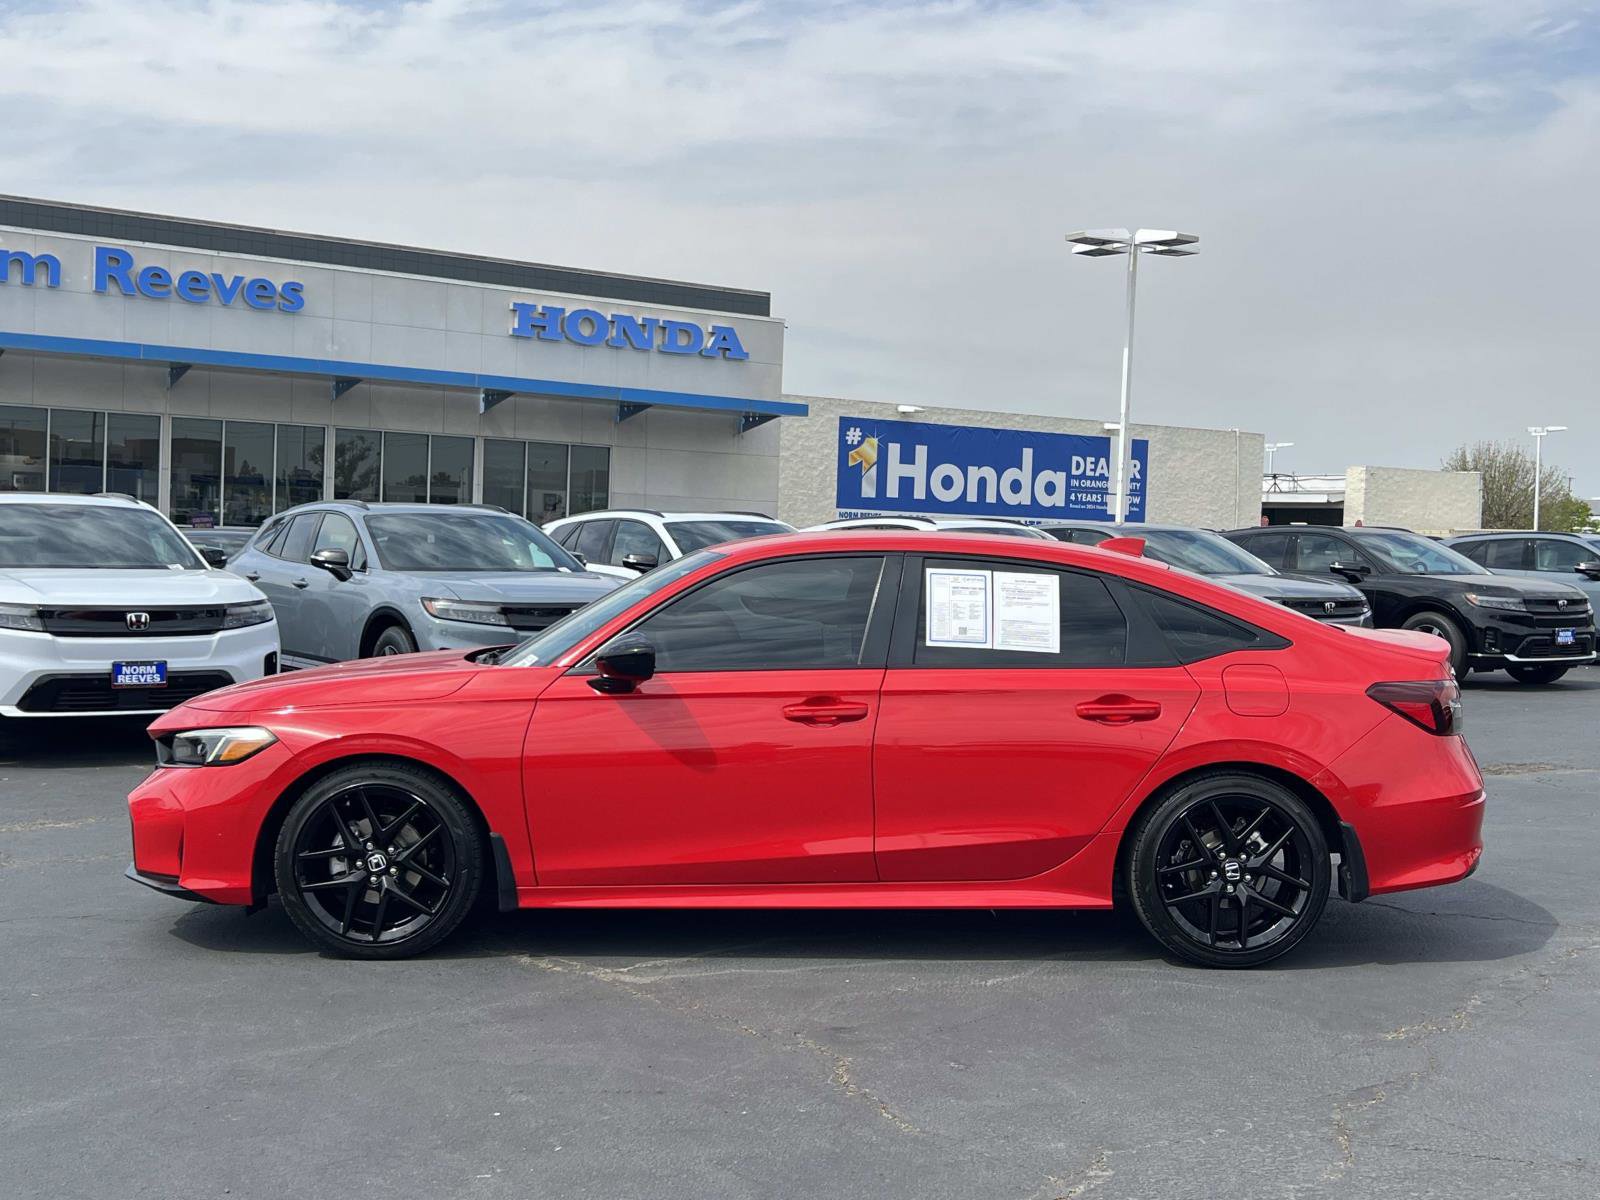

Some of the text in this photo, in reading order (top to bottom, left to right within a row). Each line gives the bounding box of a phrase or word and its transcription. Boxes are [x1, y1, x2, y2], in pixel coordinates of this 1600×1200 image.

[93, 246, 305, 313] Reeves
[509, 302, 749, 361] HONDA
[1071, 455, 1141, 479] DEAR
[886, 443, 1066, 507] Honda
[1070, 479, 1079, 487] IN
[1080, 480, 1108, 488] ORANG
[1069, 493, 1076, 501] 4
[1077, 493, 1101, 502] YEARS
[838, 511, 859, 519] NORM
[122, 665, 157, 674] NORM
[117, 674, 161, 683] REEVES
